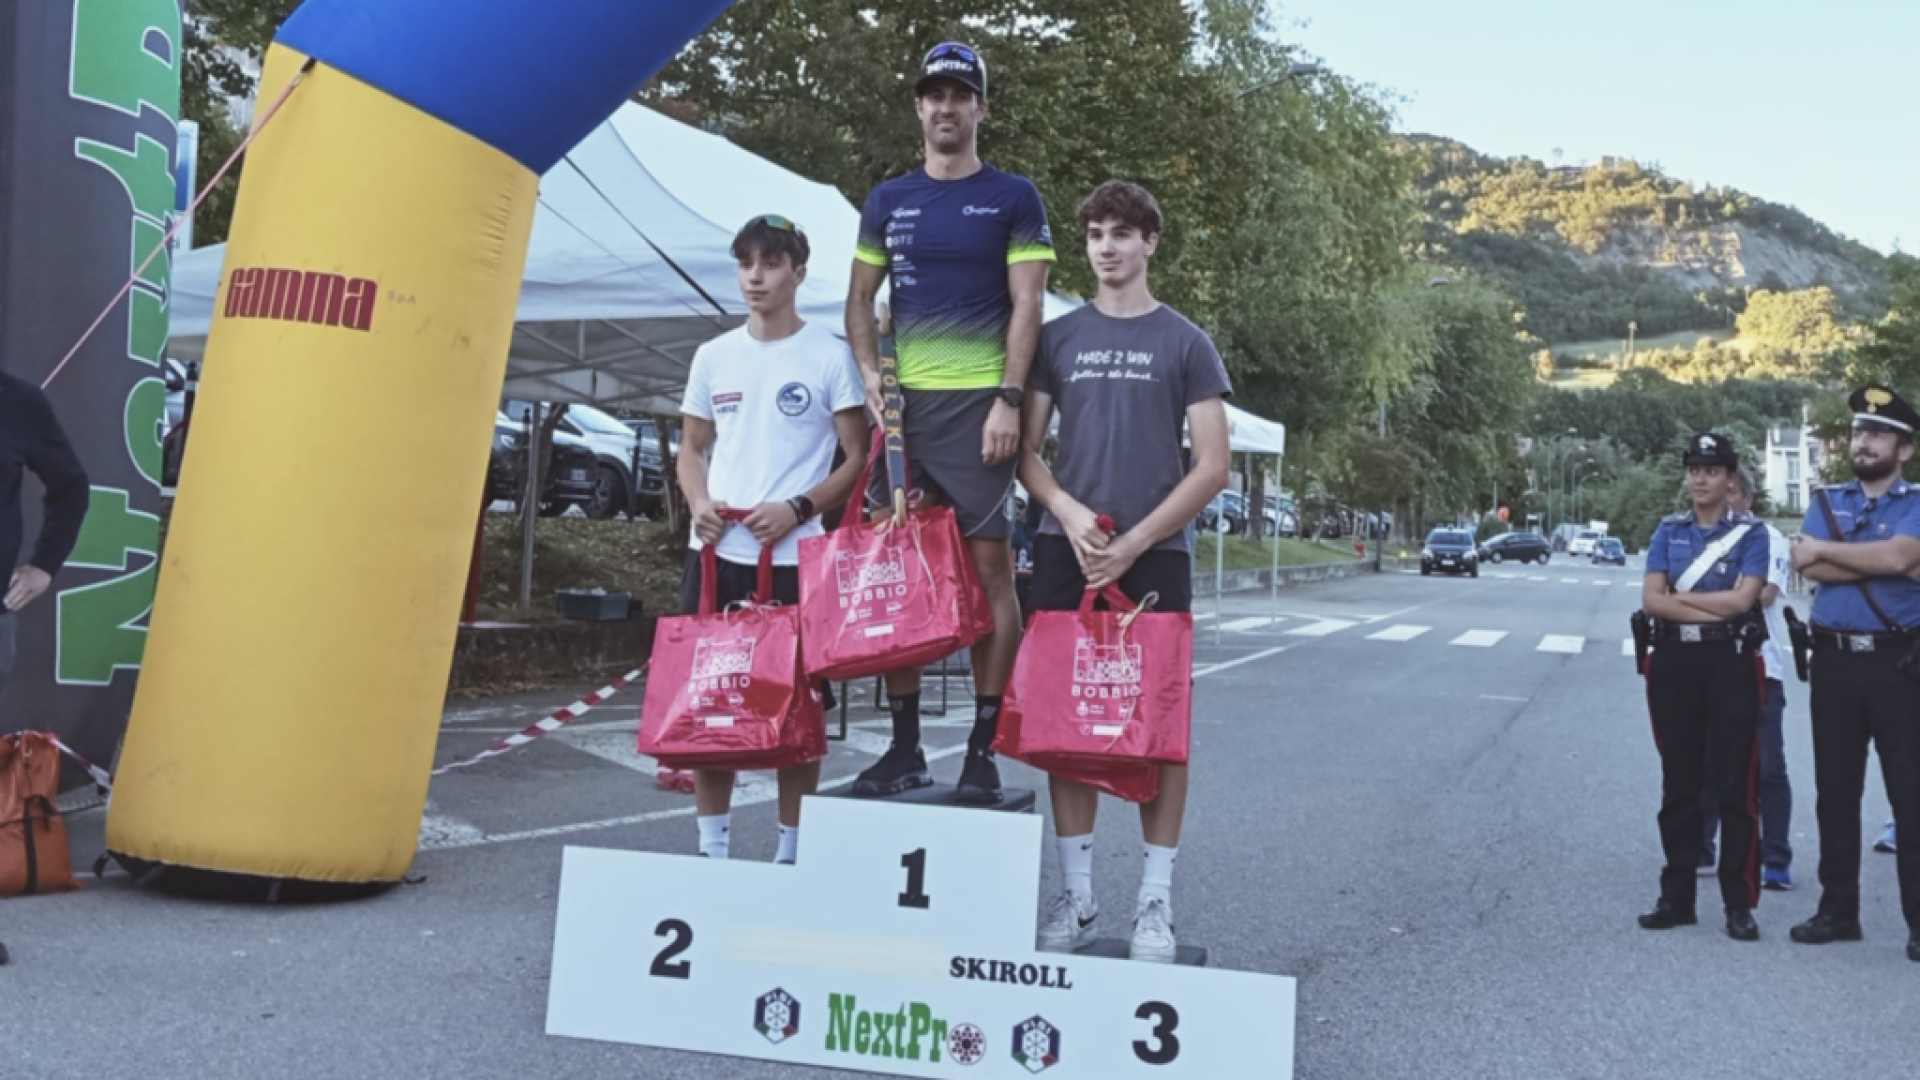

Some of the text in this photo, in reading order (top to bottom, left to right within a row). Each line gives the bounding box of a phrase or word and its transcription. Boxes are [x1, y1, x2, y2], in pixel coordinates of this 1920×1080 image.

[1113, 350, 1124, 365] 2
[838, 583, 908, 609] BOBBIO
[688, 675, 752, 694] BOBBIO
[1071, 684, 1142, 699] BOBBIO
[898, 847, 930, 910] 1
[650, 917, 693, 980] 2
[949, 956, 1073, 990] SKIROLL
[1132, 1001, 1180, 1066] 3
